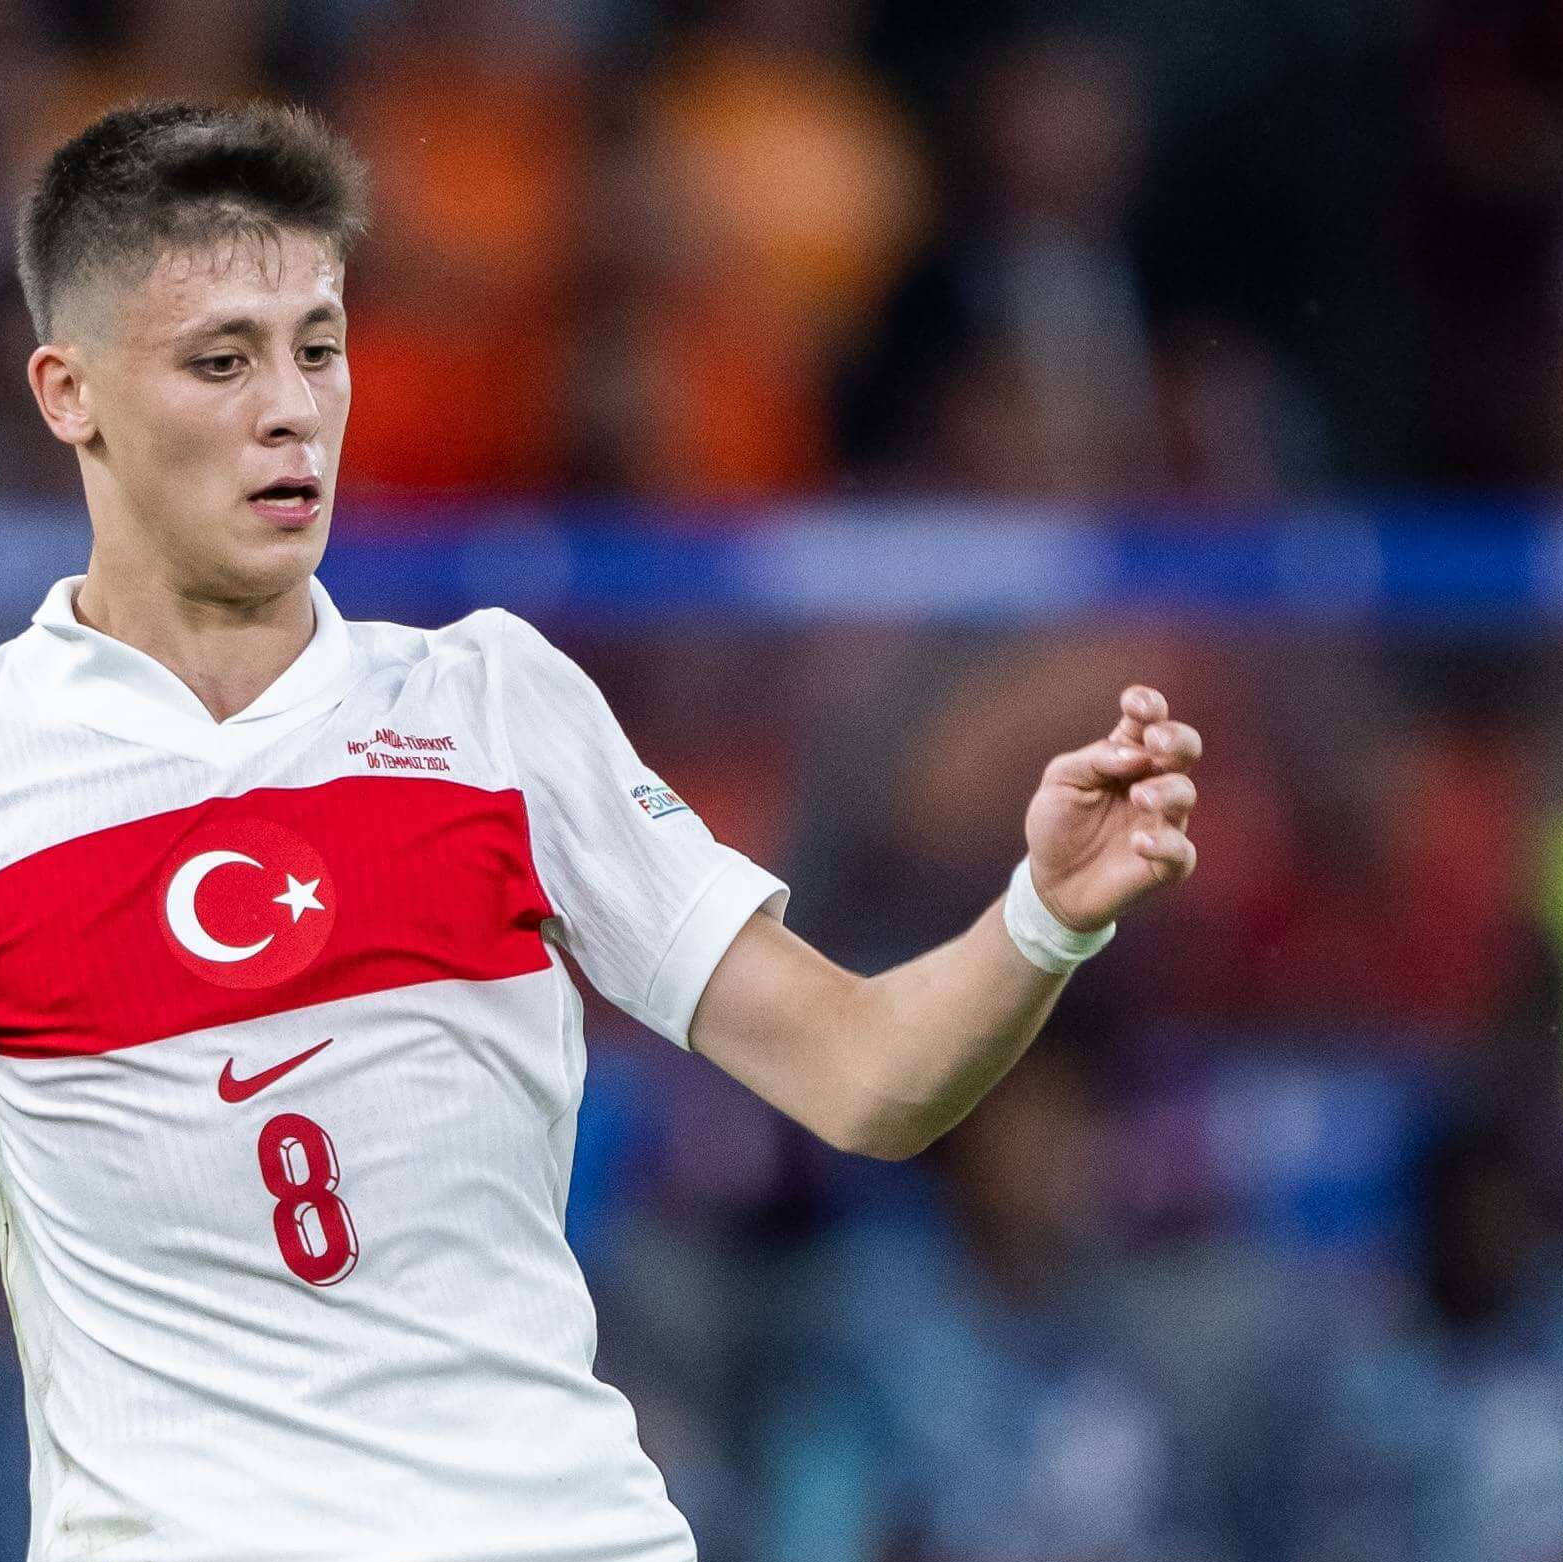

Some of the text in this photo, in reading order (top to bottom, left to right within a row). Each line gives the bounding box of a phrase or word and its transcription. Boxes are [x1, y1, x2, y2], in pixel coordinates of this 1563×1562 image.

[366, 752, 451, 772] 06 TEMMUZ 2024
[258, 1113, 359, 1287] 8
